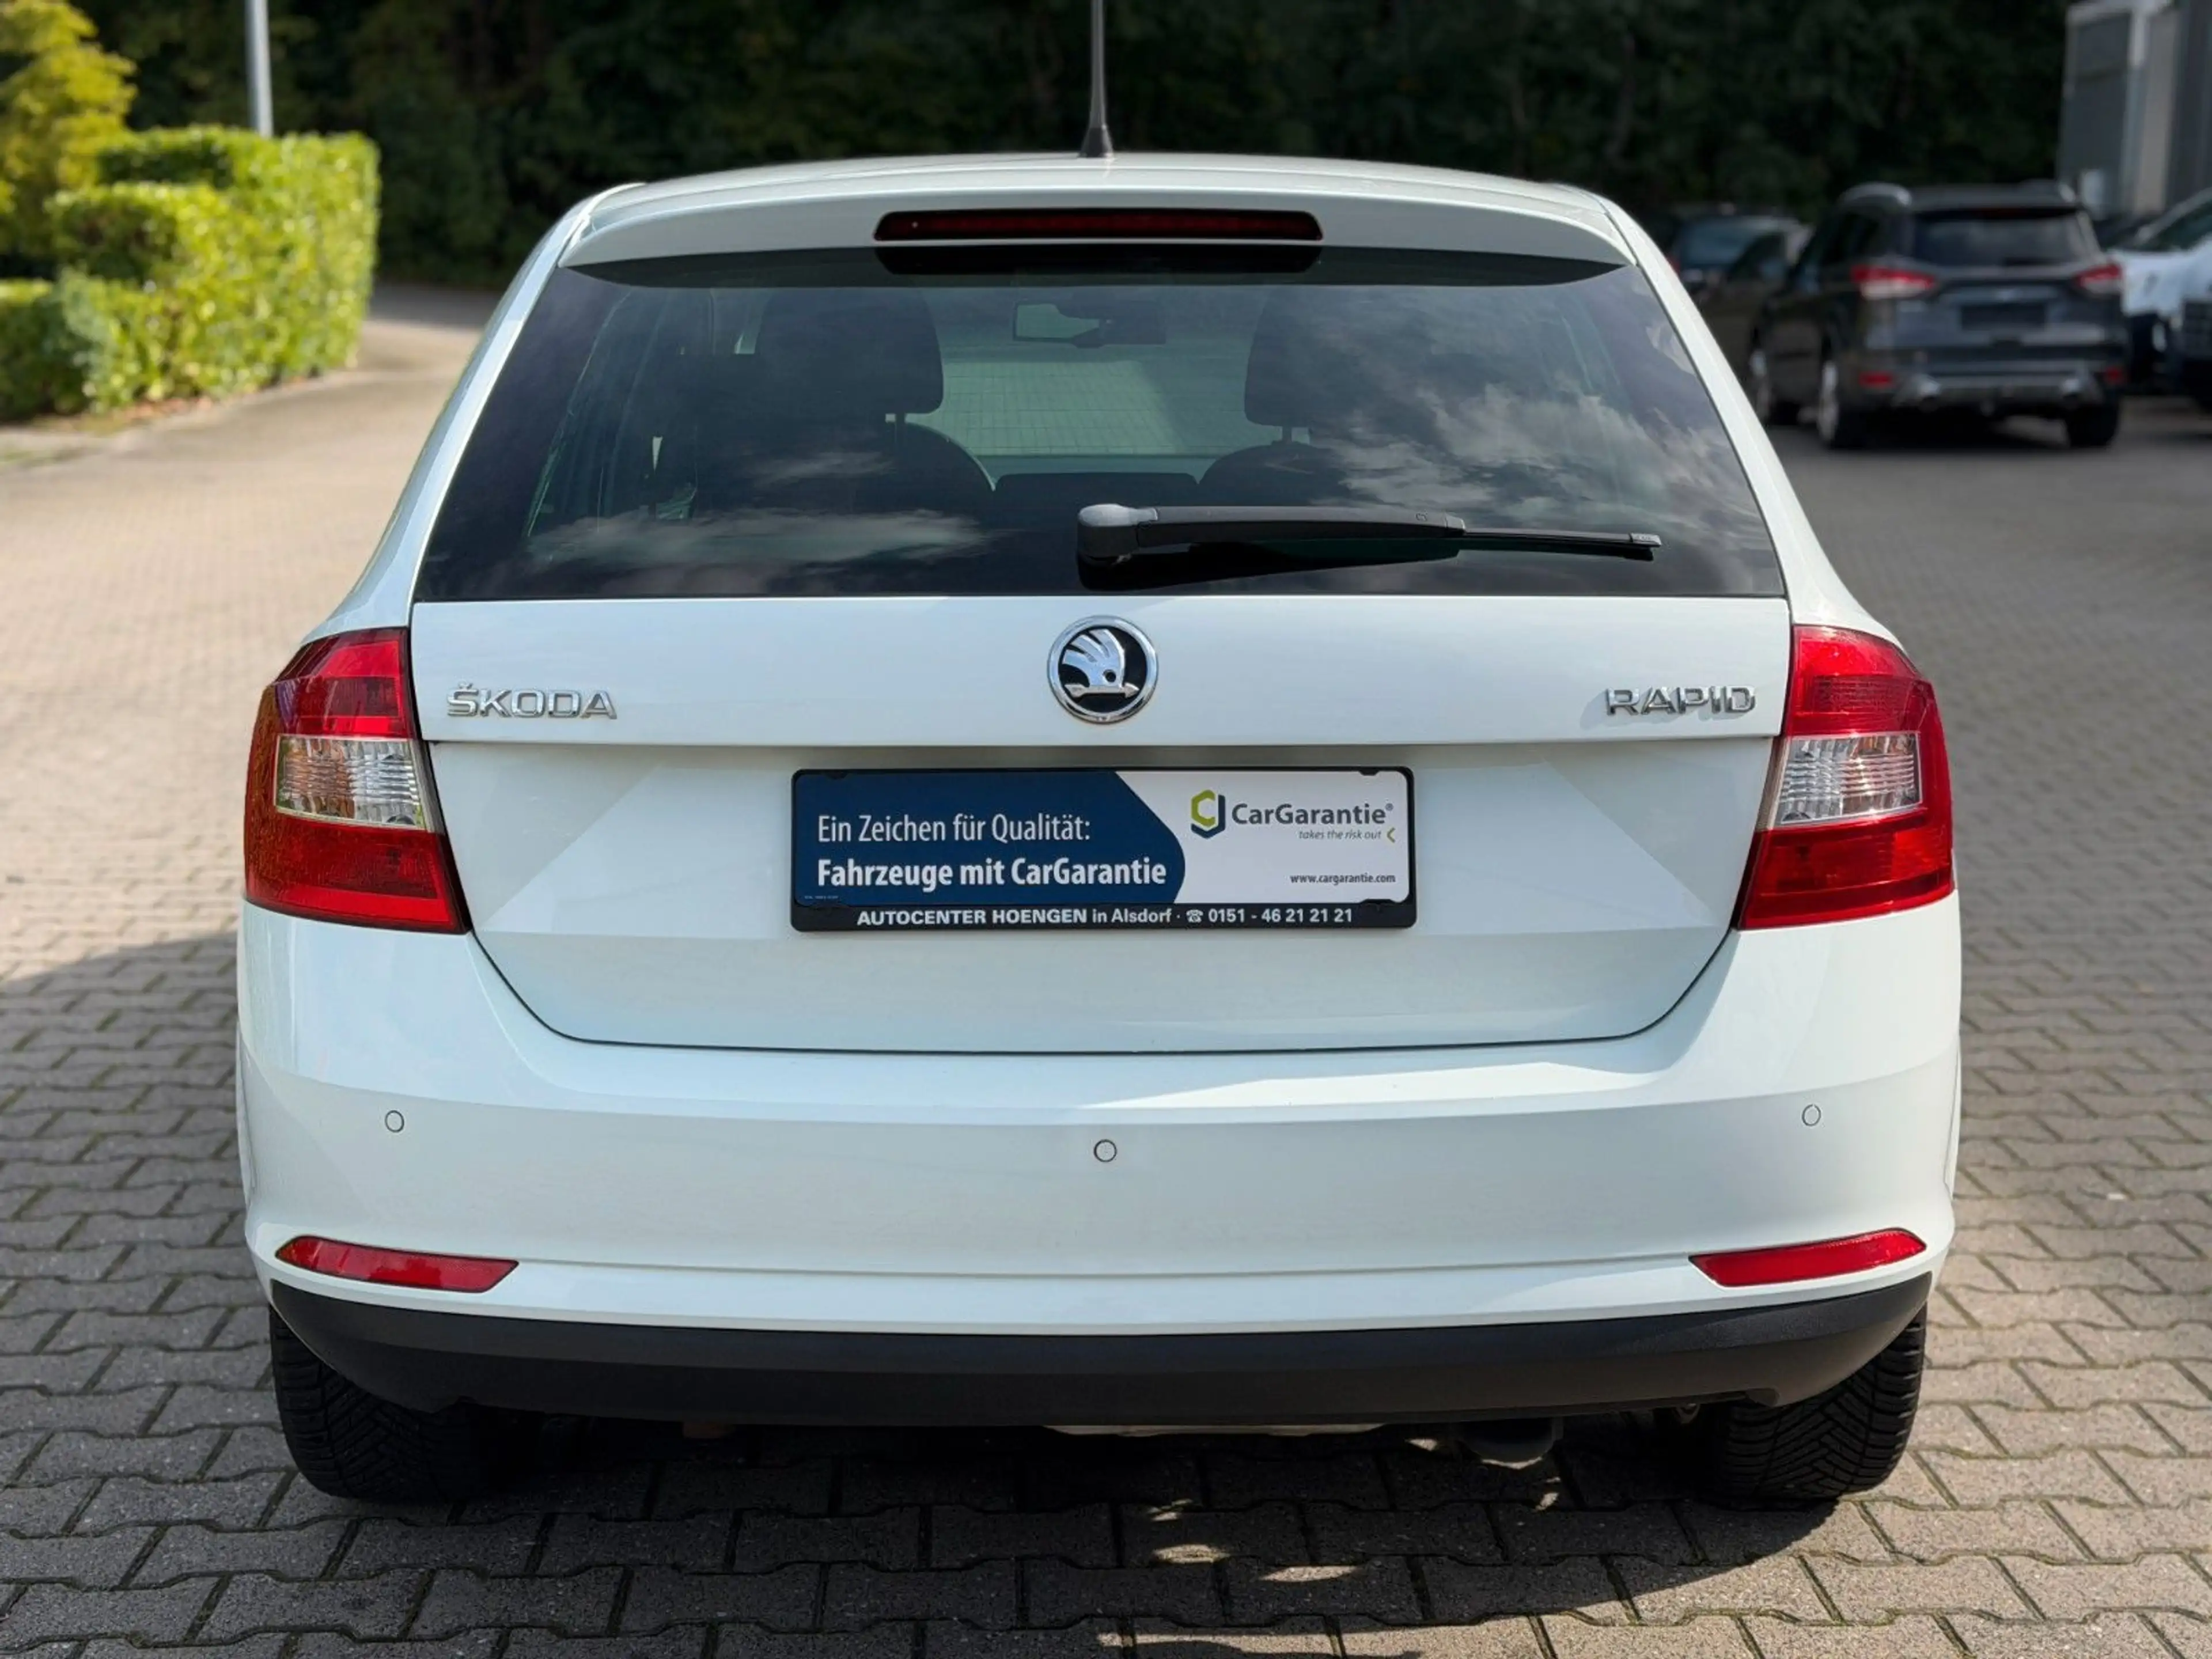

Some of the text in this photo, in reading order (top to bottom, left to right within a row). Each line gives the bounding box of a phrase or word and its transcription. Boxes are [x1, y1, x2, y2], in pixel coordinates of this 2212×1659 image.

[447, 680, 618, 719] ŠKODA
[1605, 685, 1756, 716] RAPID
[818, 813, 1090, 844] Ein Zeichen für Qualität:
[1299, 830, 1381, 839] takes the risk out
[818, 857, 1166, 892] Fahrzeuge mit CarGarantie
[1290, 872, 1396, 886] www.cargarantie.com
[857, 910, 986, 926] AUTOCENTER
[993, 909, 1087, 924] HOENGEN
[1092, 908, 1107, 922] in
[1111, 908, 1172, 923] Alsdorf
[1208, 908, 1245, 922] 0151
[1261, 908, 1281, 922] 46
[1285, 908, 1304, 922] 21
[1309, 908, 1328, 922] 21
[1334, 908, 1352, 922] 21
